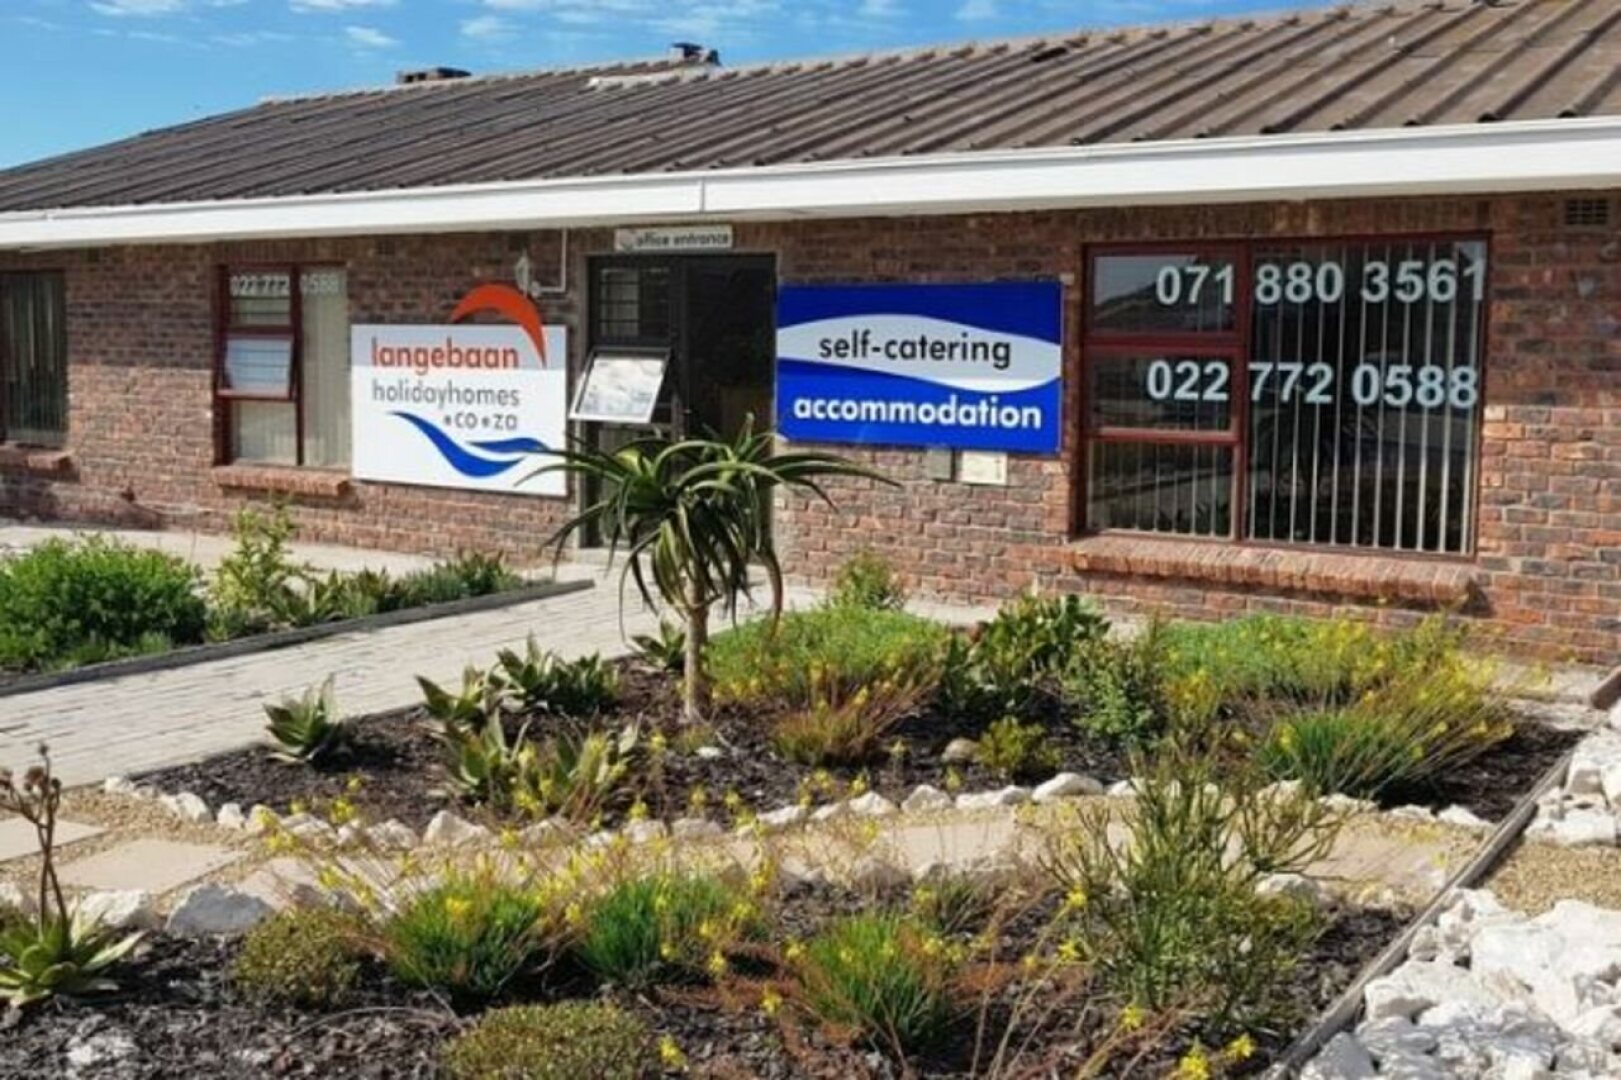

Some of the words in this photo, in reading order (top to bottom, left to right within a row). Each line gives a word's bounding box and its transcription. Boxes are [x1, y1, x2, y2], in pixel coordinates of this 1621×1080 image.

[637, 231, 669, 247] office
[673, 230, 729, 246] entrance
[1156, 264, 1235, 304] 071
[1255, 261, 1344, 304] 880
[1361, 259, 1486, 302] 3561
[371, 336, 519, 375] langebaan
[819, 330, 1011, 370] self-catering
[371, 378, 520, 409] holidayhomes
[1147, 360, 1230, 401] 022
[1248, 362, 1333, 404] 772
[1352, 363, 1478, 408] 0588
[794, 395, 1042, 428] accommodation
